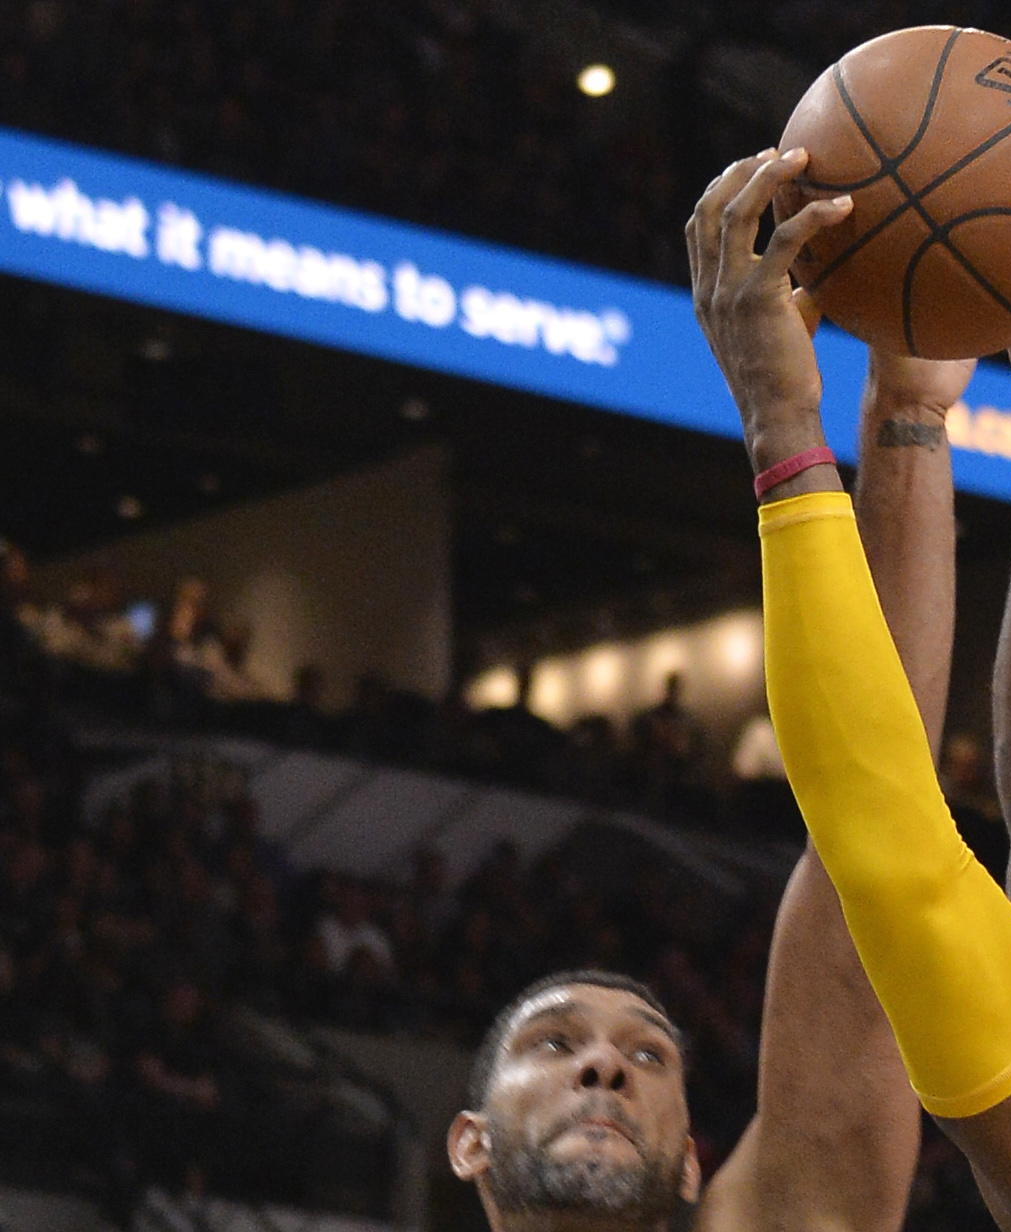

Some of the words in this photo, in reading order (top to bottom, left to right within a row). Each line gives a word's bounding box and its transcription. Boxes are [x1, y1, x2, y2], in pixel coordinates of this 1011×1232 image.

[8, 178, 149, 257] what
[157, 202, 202, 271] it
[208, 225, 389, 313] means
[392, 262, 457, 329] to
